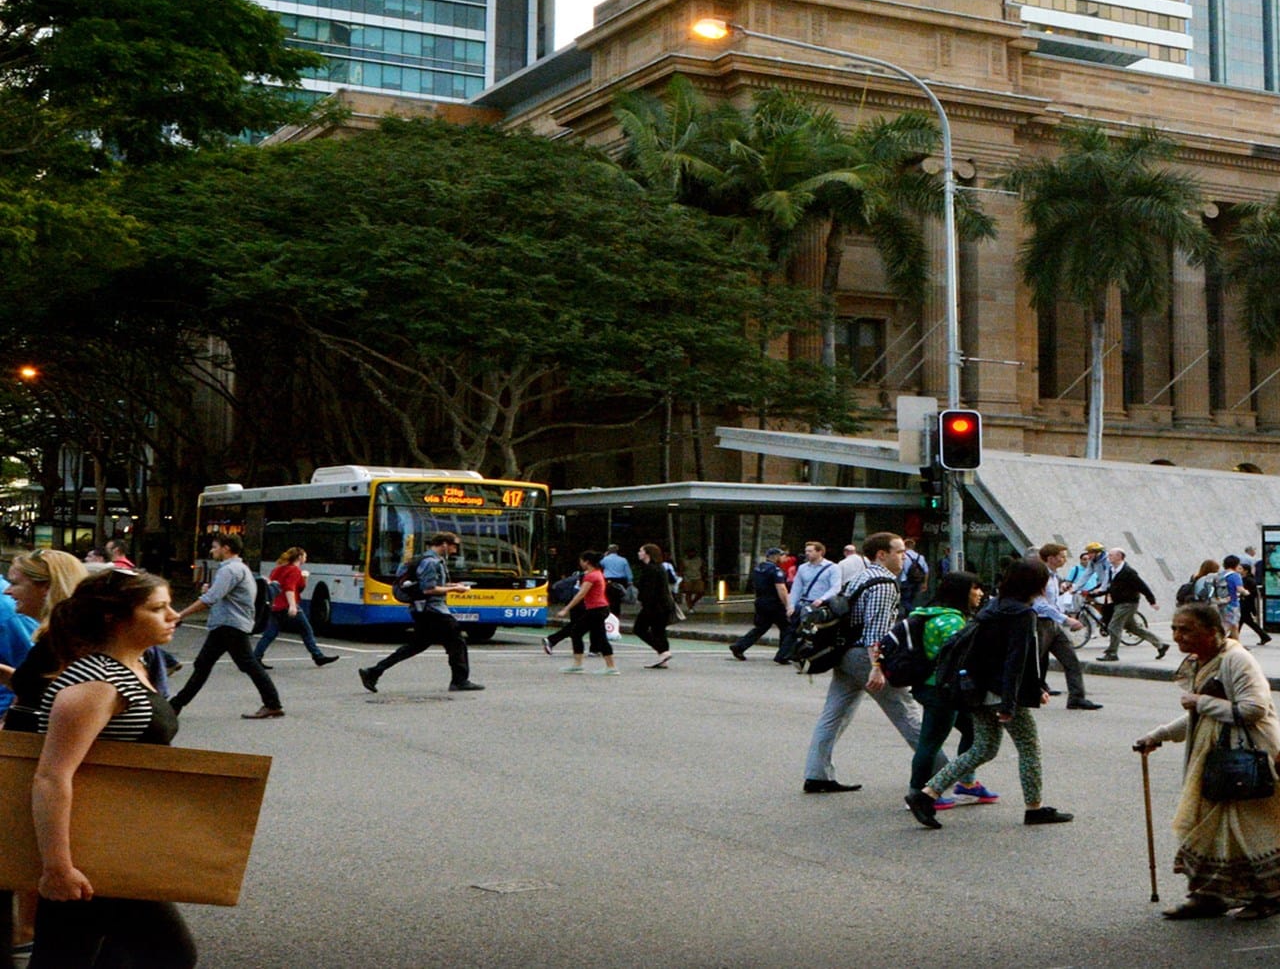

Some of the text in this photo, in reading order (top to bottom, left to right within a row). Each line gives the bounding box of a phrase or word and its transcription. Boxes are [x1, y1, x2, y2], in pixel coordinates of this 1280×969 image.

[445, 488, 464, 497] City
[423, 495, 483, 505] via Toowong
[502, 490, 523, 507] 417
[923, 522, 939, 535] King
